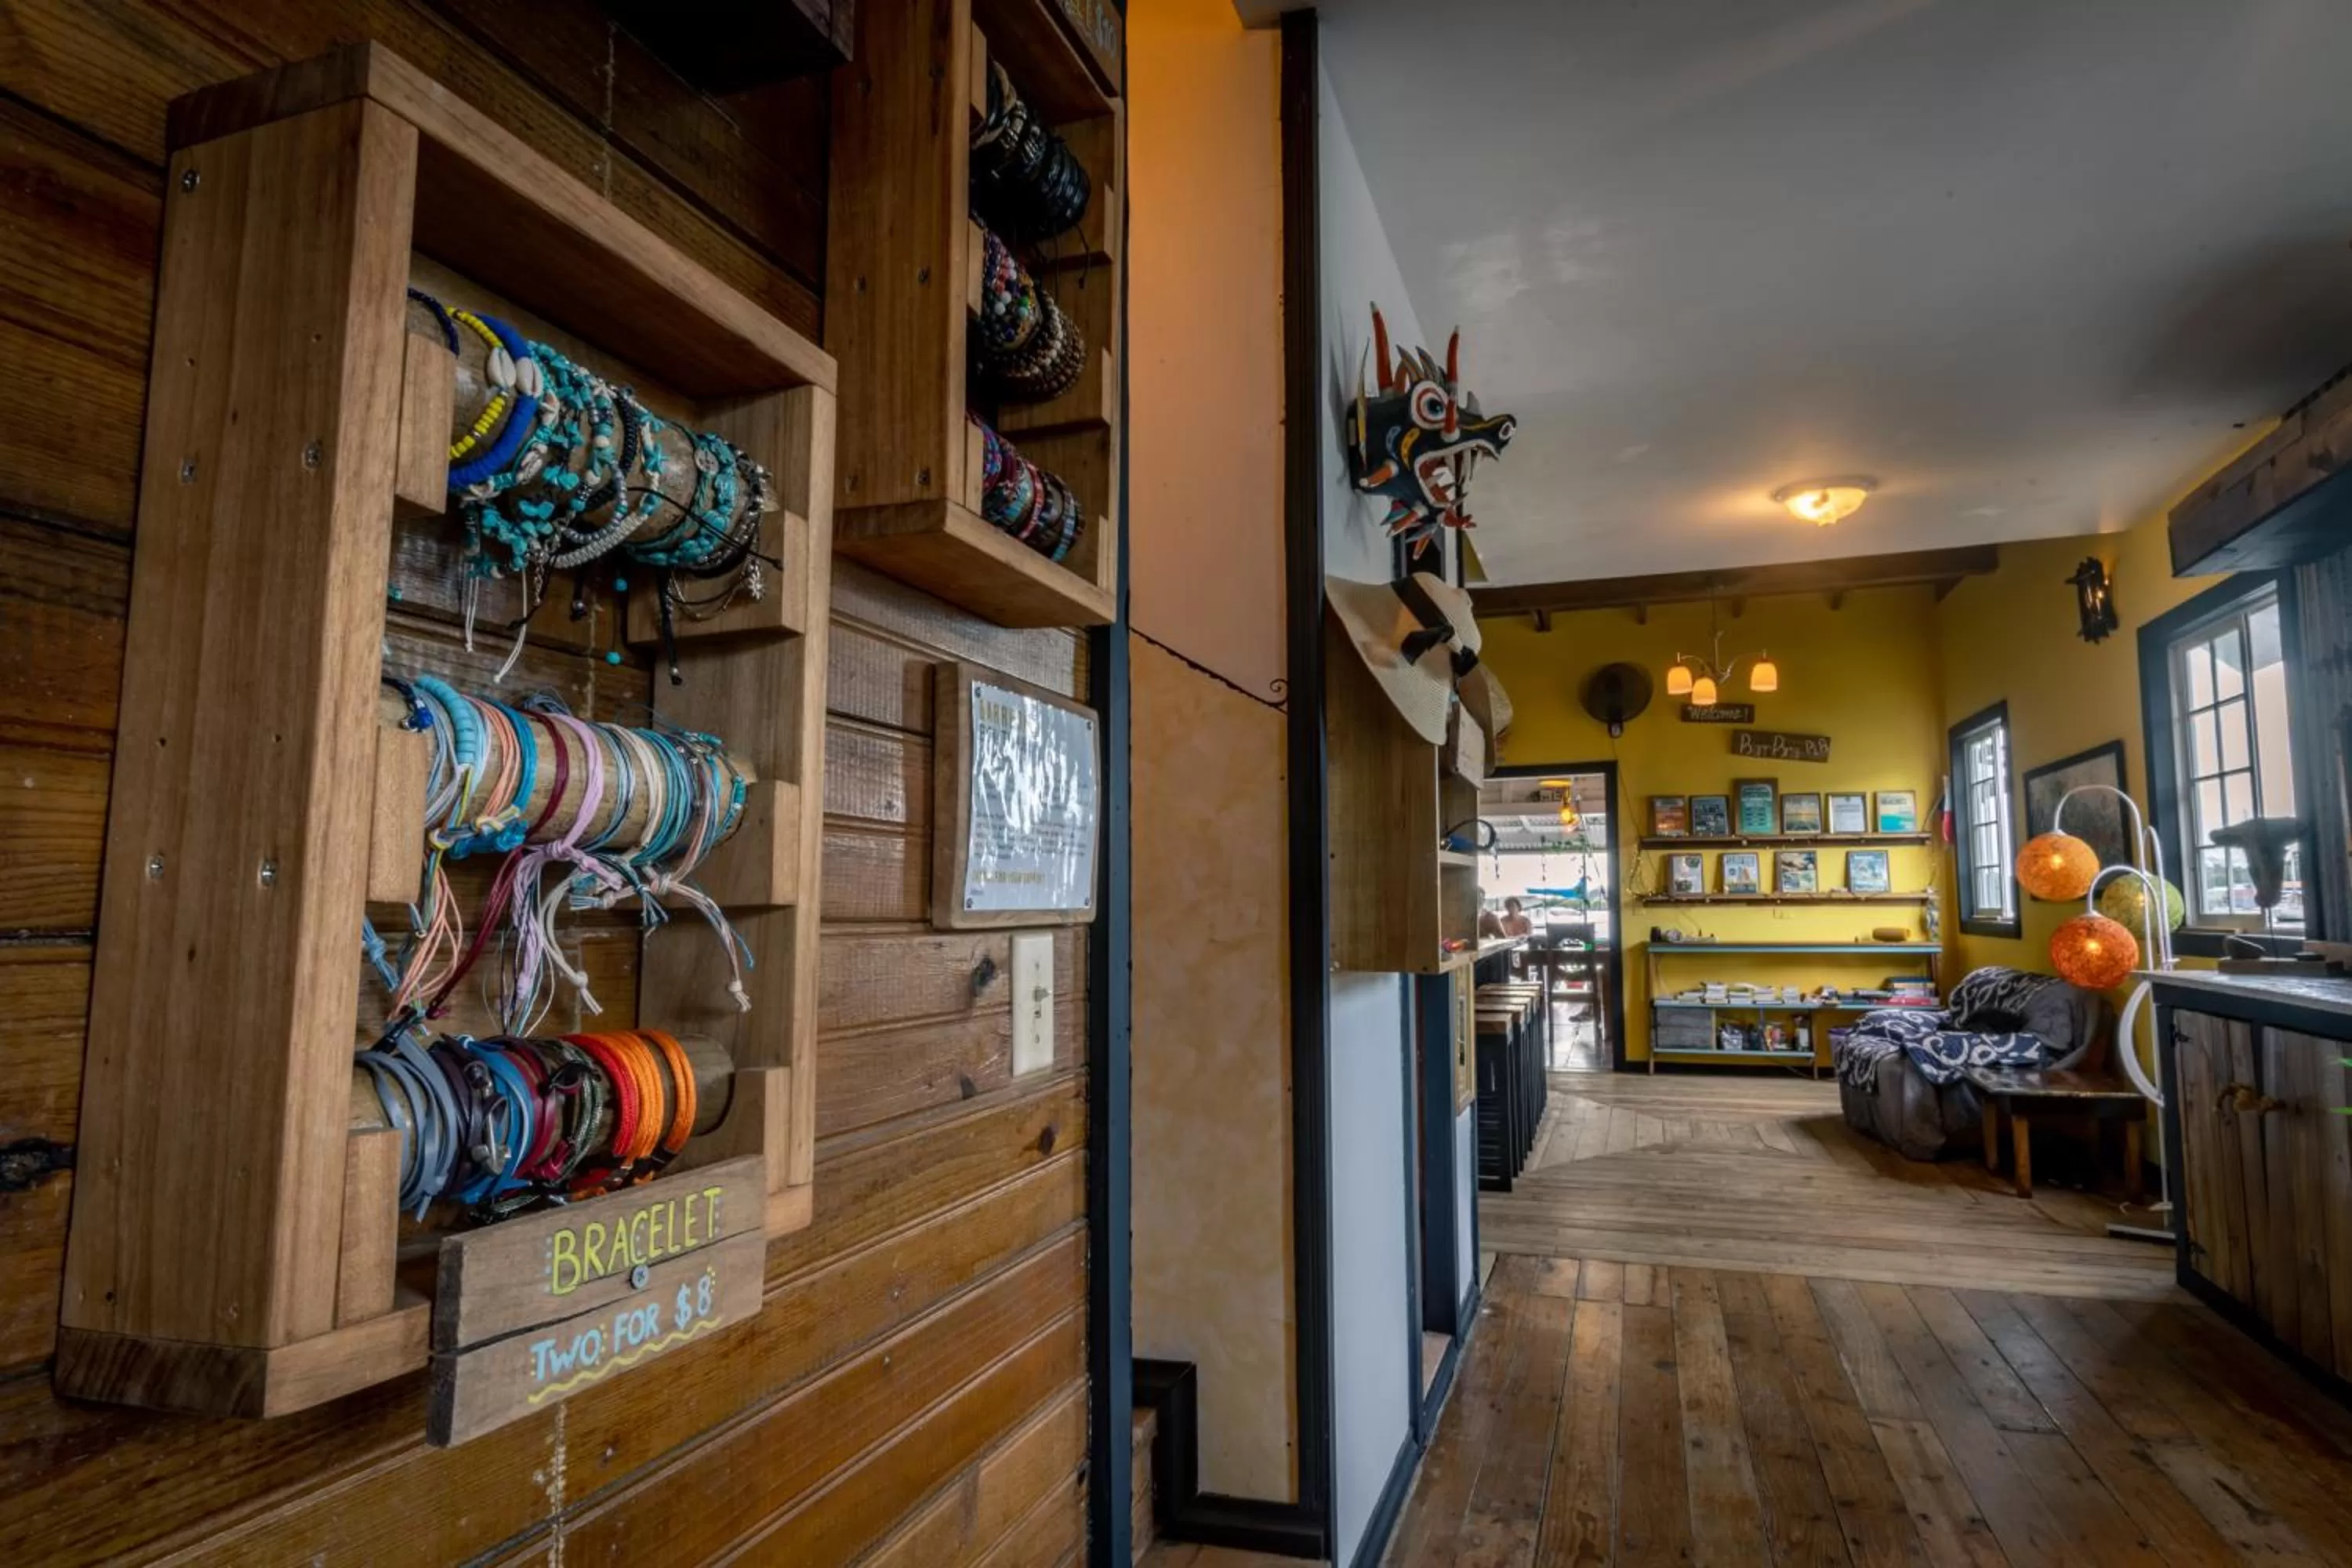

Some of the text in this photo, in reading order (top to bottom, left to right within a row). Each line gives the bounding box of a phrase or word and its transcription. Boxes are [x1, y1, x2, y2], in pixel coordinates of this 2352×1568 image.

[551, 1186, 722, 1295] BRACELET
[530, 1273, 712, 1381] TWO FOR $8
